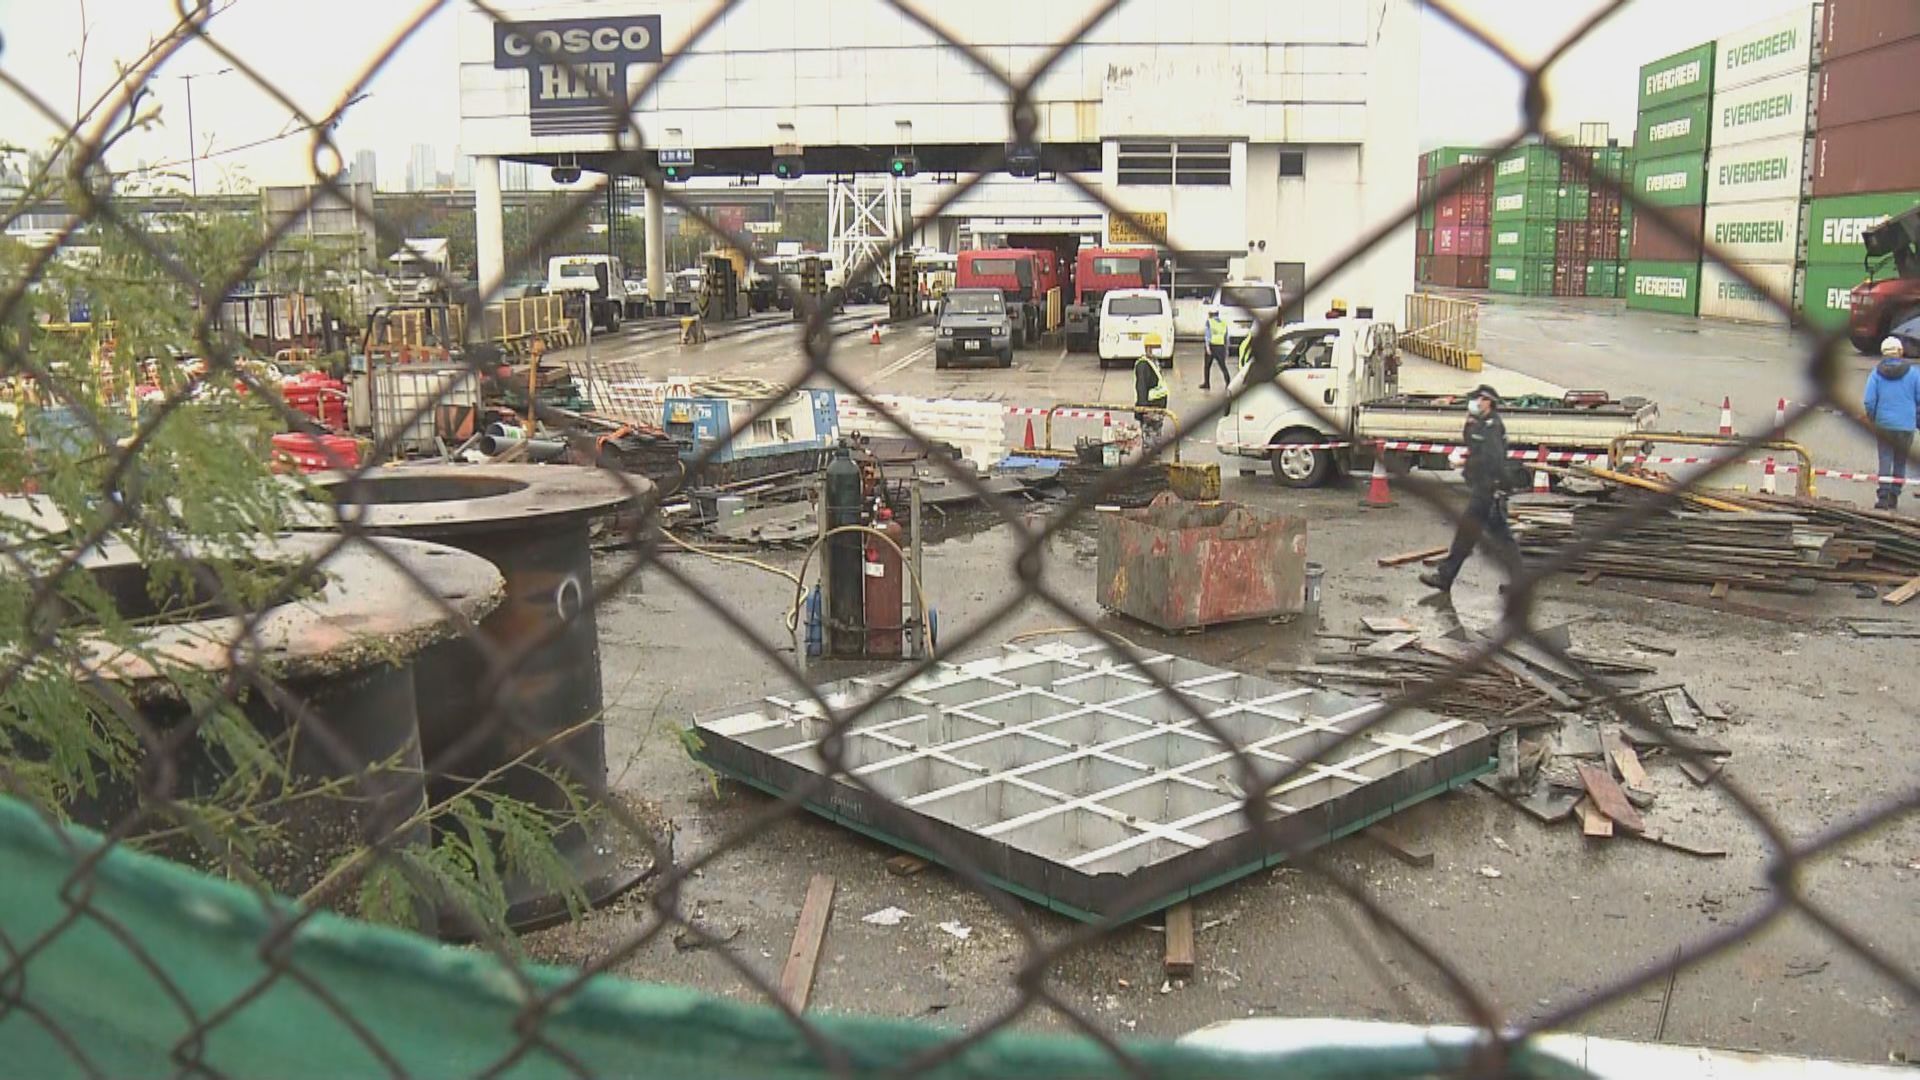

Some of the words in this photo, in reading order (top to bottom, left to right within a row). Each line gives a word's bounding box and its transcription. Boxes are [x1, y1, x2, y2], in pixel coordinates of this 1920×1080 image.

[504, 26, 650, 57] COSCO
[1726, 28, 1797, 70] EVERGREEN
[539, 62, 616, 100] HIT
[1646, 60, 1701, 96] EVERGREEN
[1723, 93, 1793, 128] EVERGREEN
[1719, 157, 1788, 185] EVERGREEN
[1715, 220, 1784, 243] EVERGREEN
[1822, 217, 1886, 244] EVER
[1634, 276, 1688, 298] EVERGREEN
